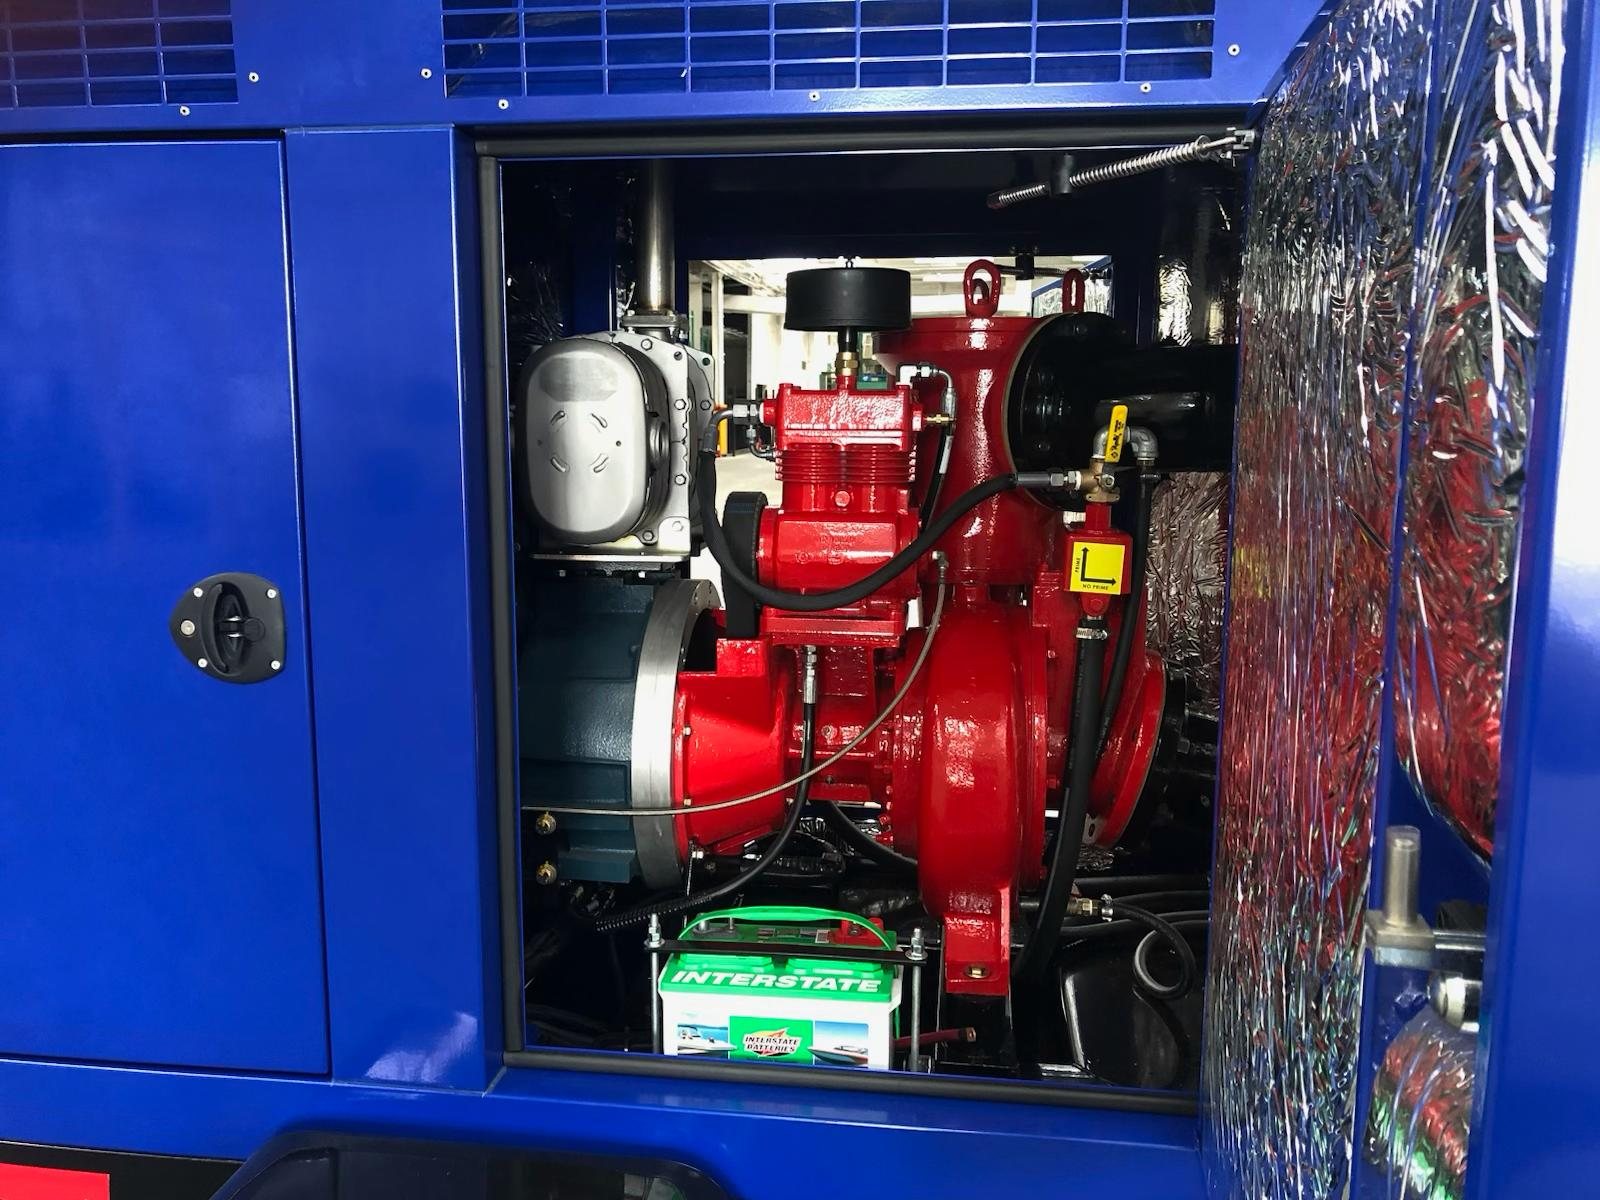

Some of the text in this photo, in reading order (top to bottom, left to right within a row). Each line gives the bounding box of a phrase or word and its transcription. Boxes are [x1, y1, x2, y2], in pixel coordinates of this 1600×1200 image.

[671, 971, 881, 992] INTERSTATE
[745, 1036, 798, 1045] INTERSTATE
[747, 1044, 795, 1052] BATTERIES
